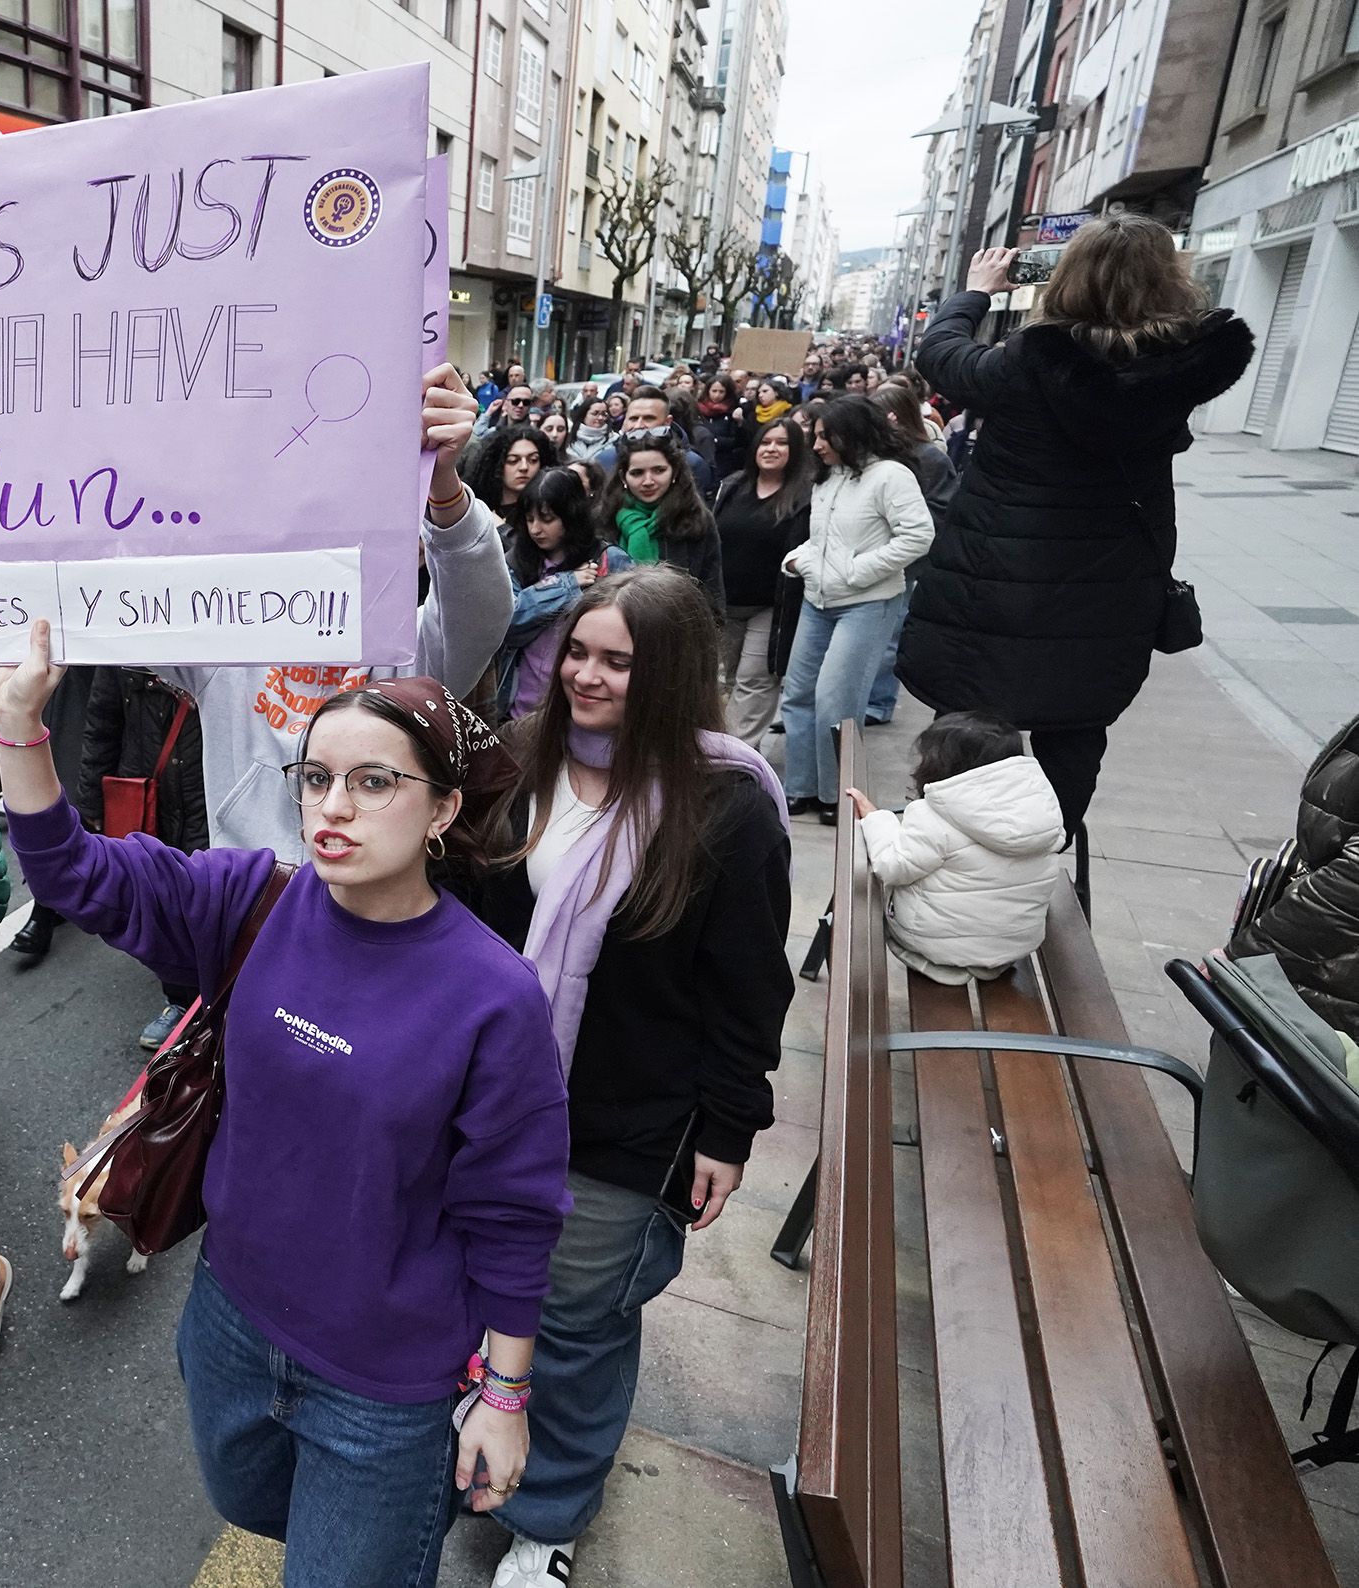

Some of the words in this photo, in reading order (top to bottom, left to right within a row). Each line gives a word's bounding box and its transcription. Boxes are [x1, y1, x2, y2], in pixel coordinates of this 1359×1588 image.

[73, 155, 311, 282] JUST
[73, 303, 278, 408] HAVE
[79, 586, 103, 628] Y
